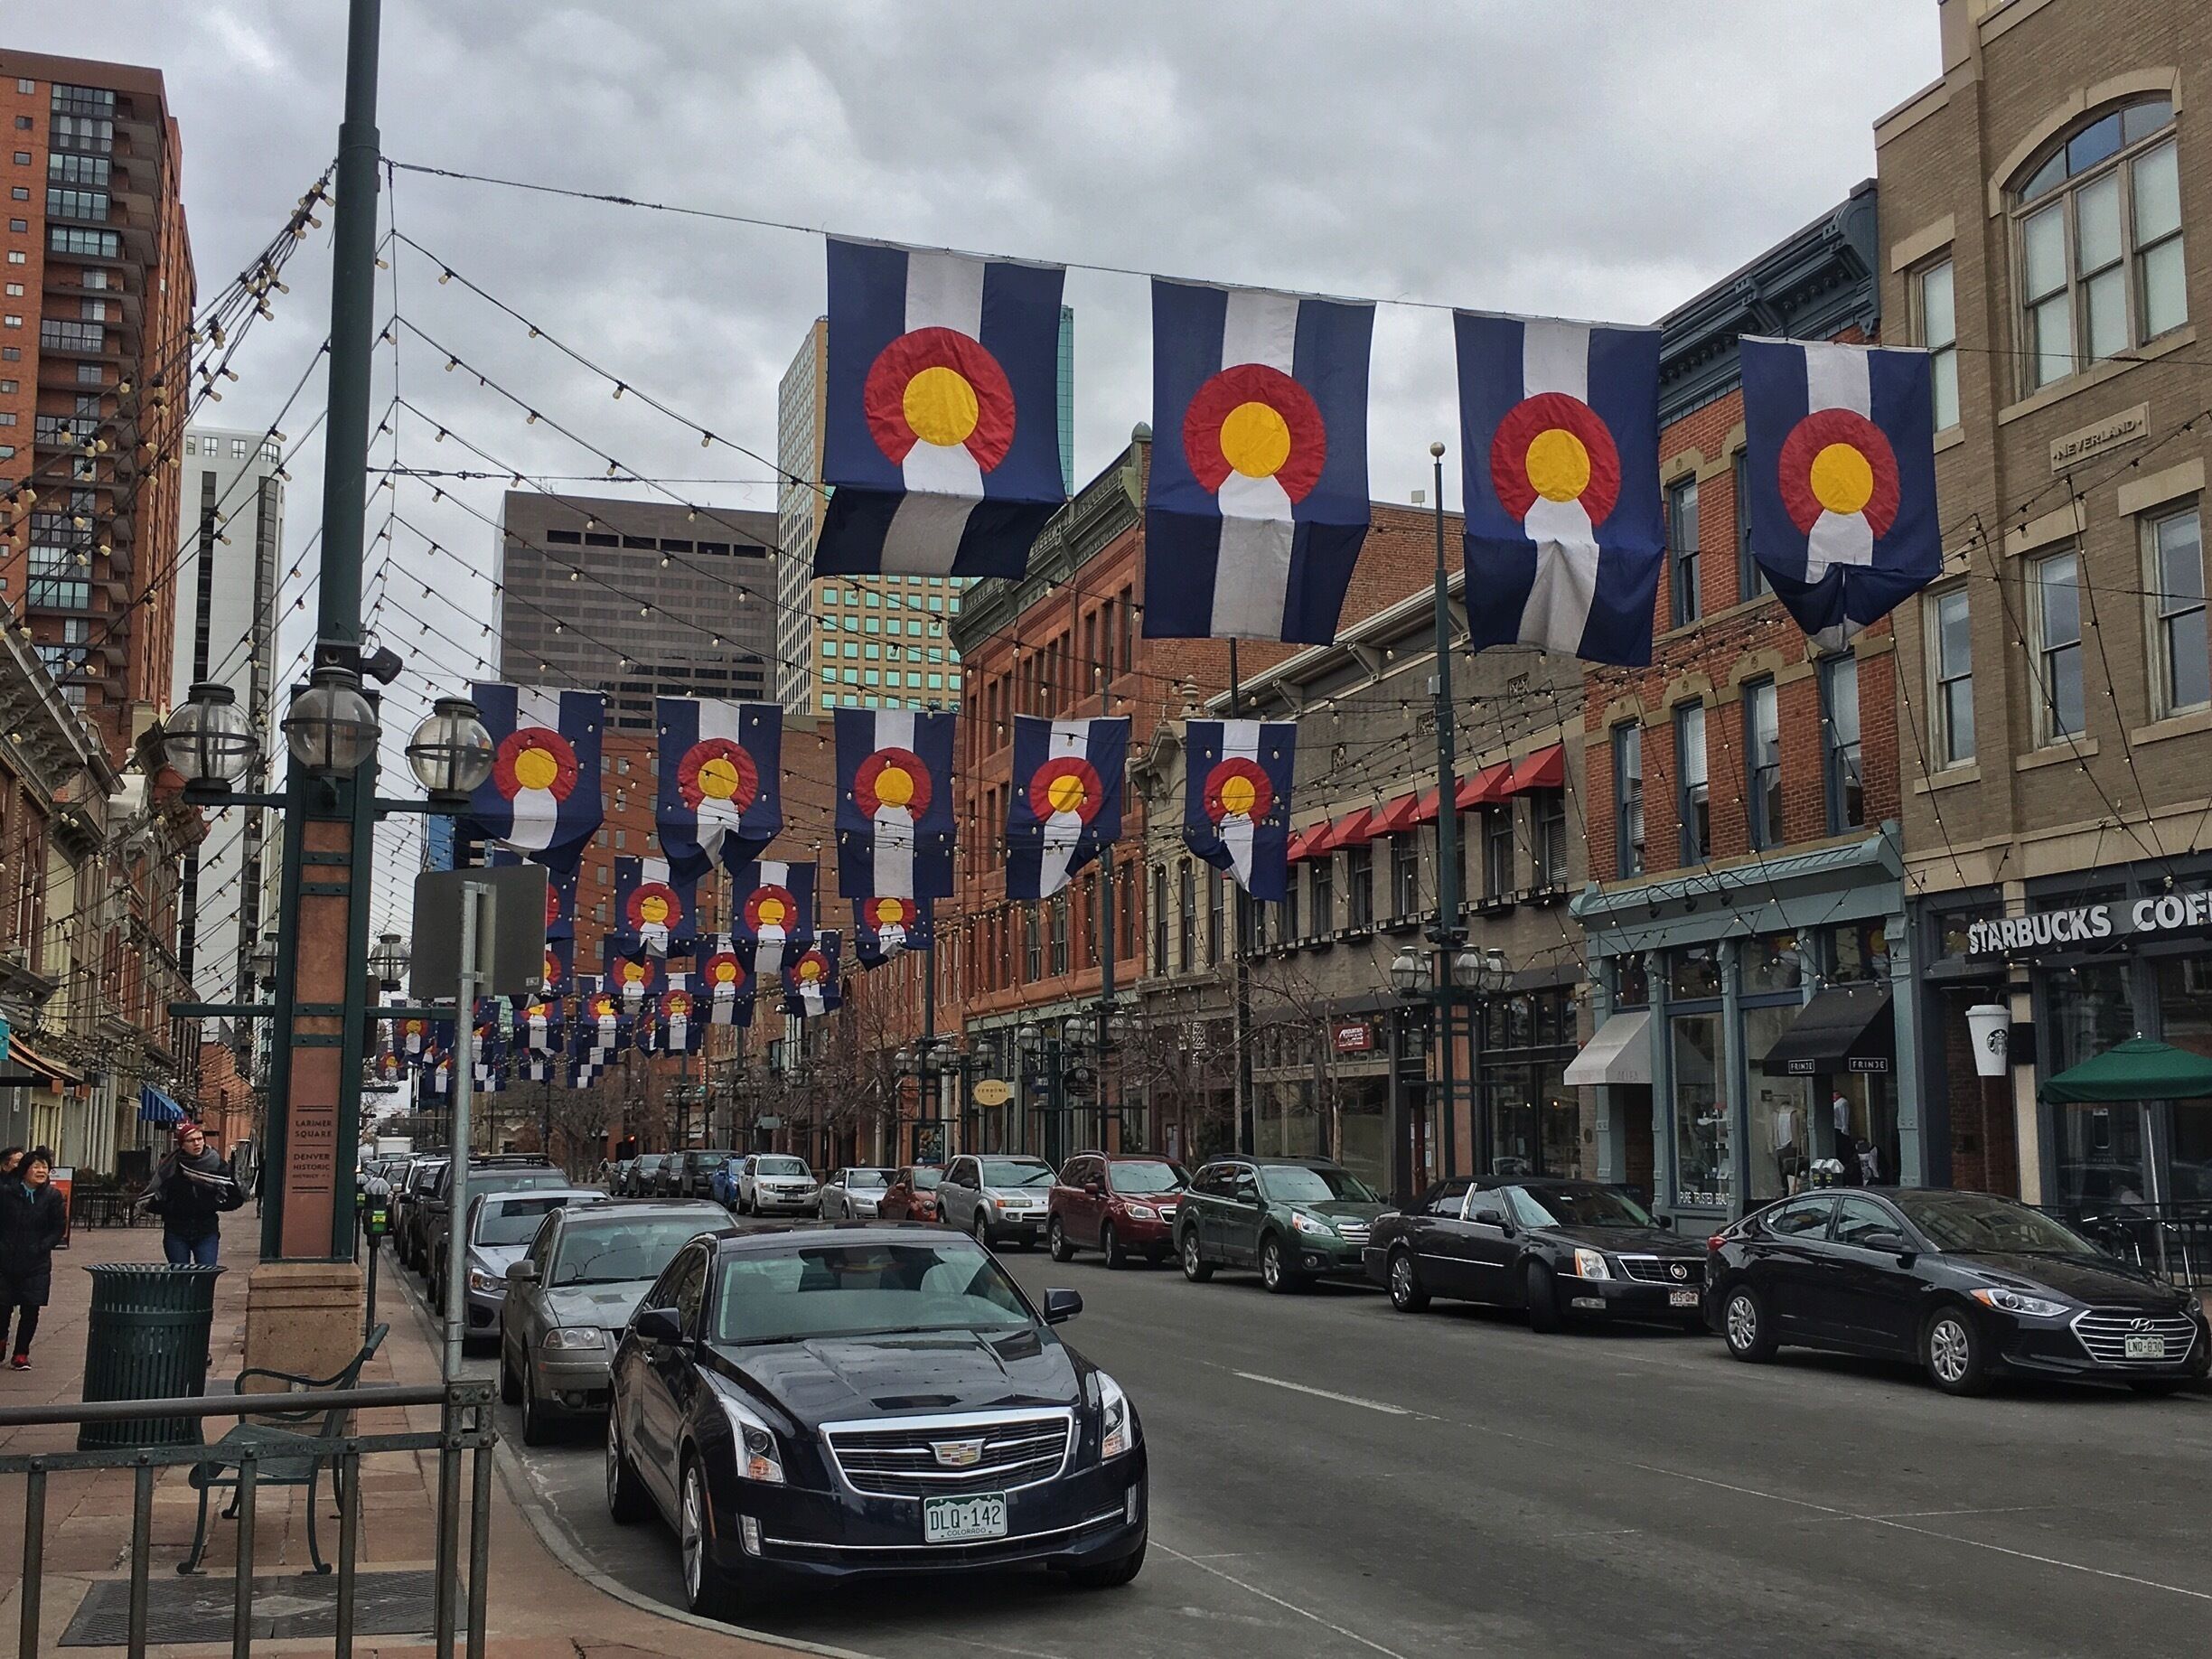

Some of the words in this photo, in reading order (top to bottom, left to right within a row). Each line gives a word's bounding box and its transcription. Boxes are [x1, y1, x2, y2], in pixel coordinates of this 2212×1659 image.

[2057, 419, 2137, 461] NEVERLAND
[1968, 904, 2112, 955] STARBUCKS
[2132, 890, 2212, 932] COF
[295, 1120, 333, 1128] LARIMER
[295, 1130, 332, 1139] SQUARE
[294, 1153, 331, 1161] DENVER
[946, 1527, 987, 1537] COLORADO
